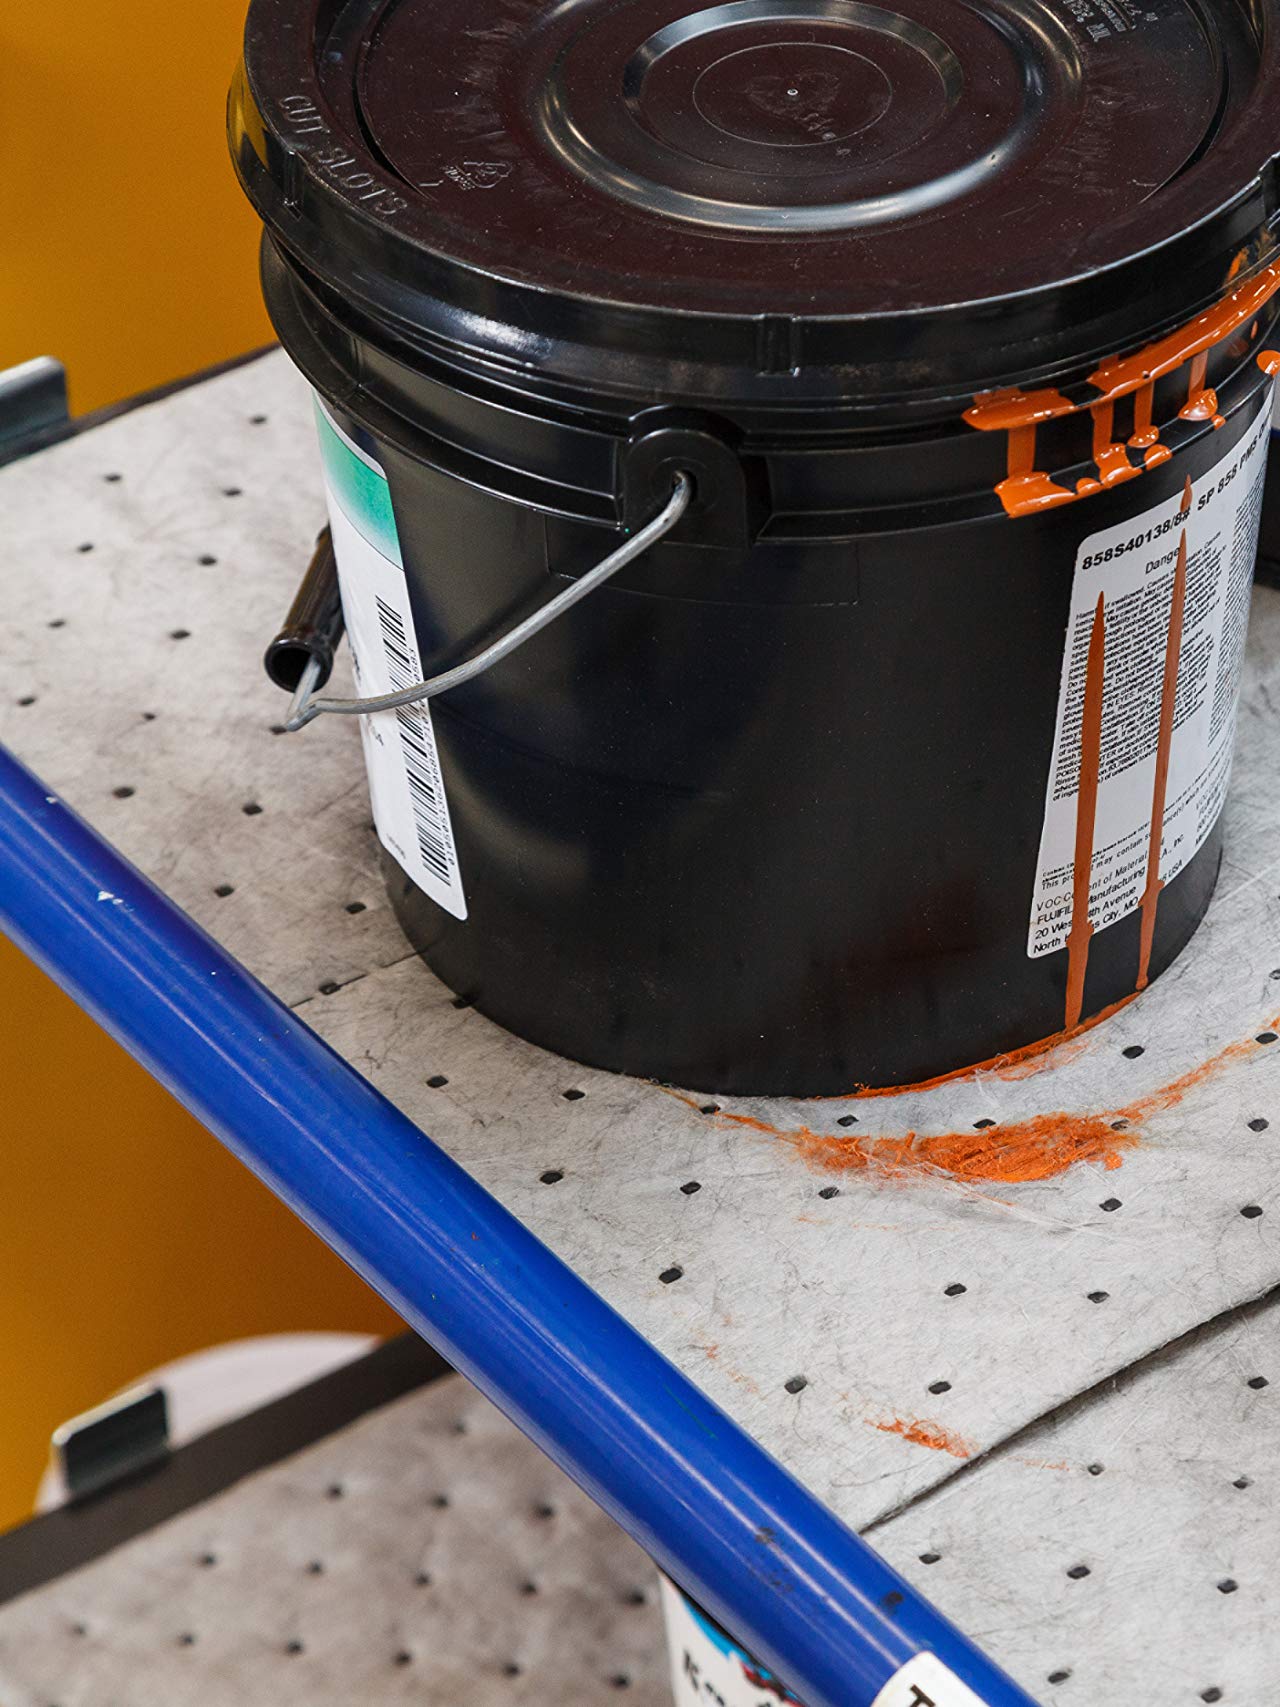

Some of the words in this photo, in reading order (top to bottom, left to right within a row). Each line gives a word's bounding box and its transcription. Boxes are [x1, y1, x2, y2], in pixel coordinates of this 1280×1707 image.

[1082, 507, 1190, 570] 858S40138/8#
[1197, 487, 1215, 510] SP
[1145, 548, 1181, 575] Dange
[1041, 880, 1058, 890] This
[1096, 855, 1113, 868] may
[1116, 838, 1143, 858] contain
[1115, 850, 1147, 877] Material
[1035, 927, 1049, 940] 20
[1051, 919, 1073, 935] Wes
[1102, 886, 1137, 911] Avenue
[1037, 905, 1073, 925] FUJIFIL
[1033, 936, 1061, 954] North
